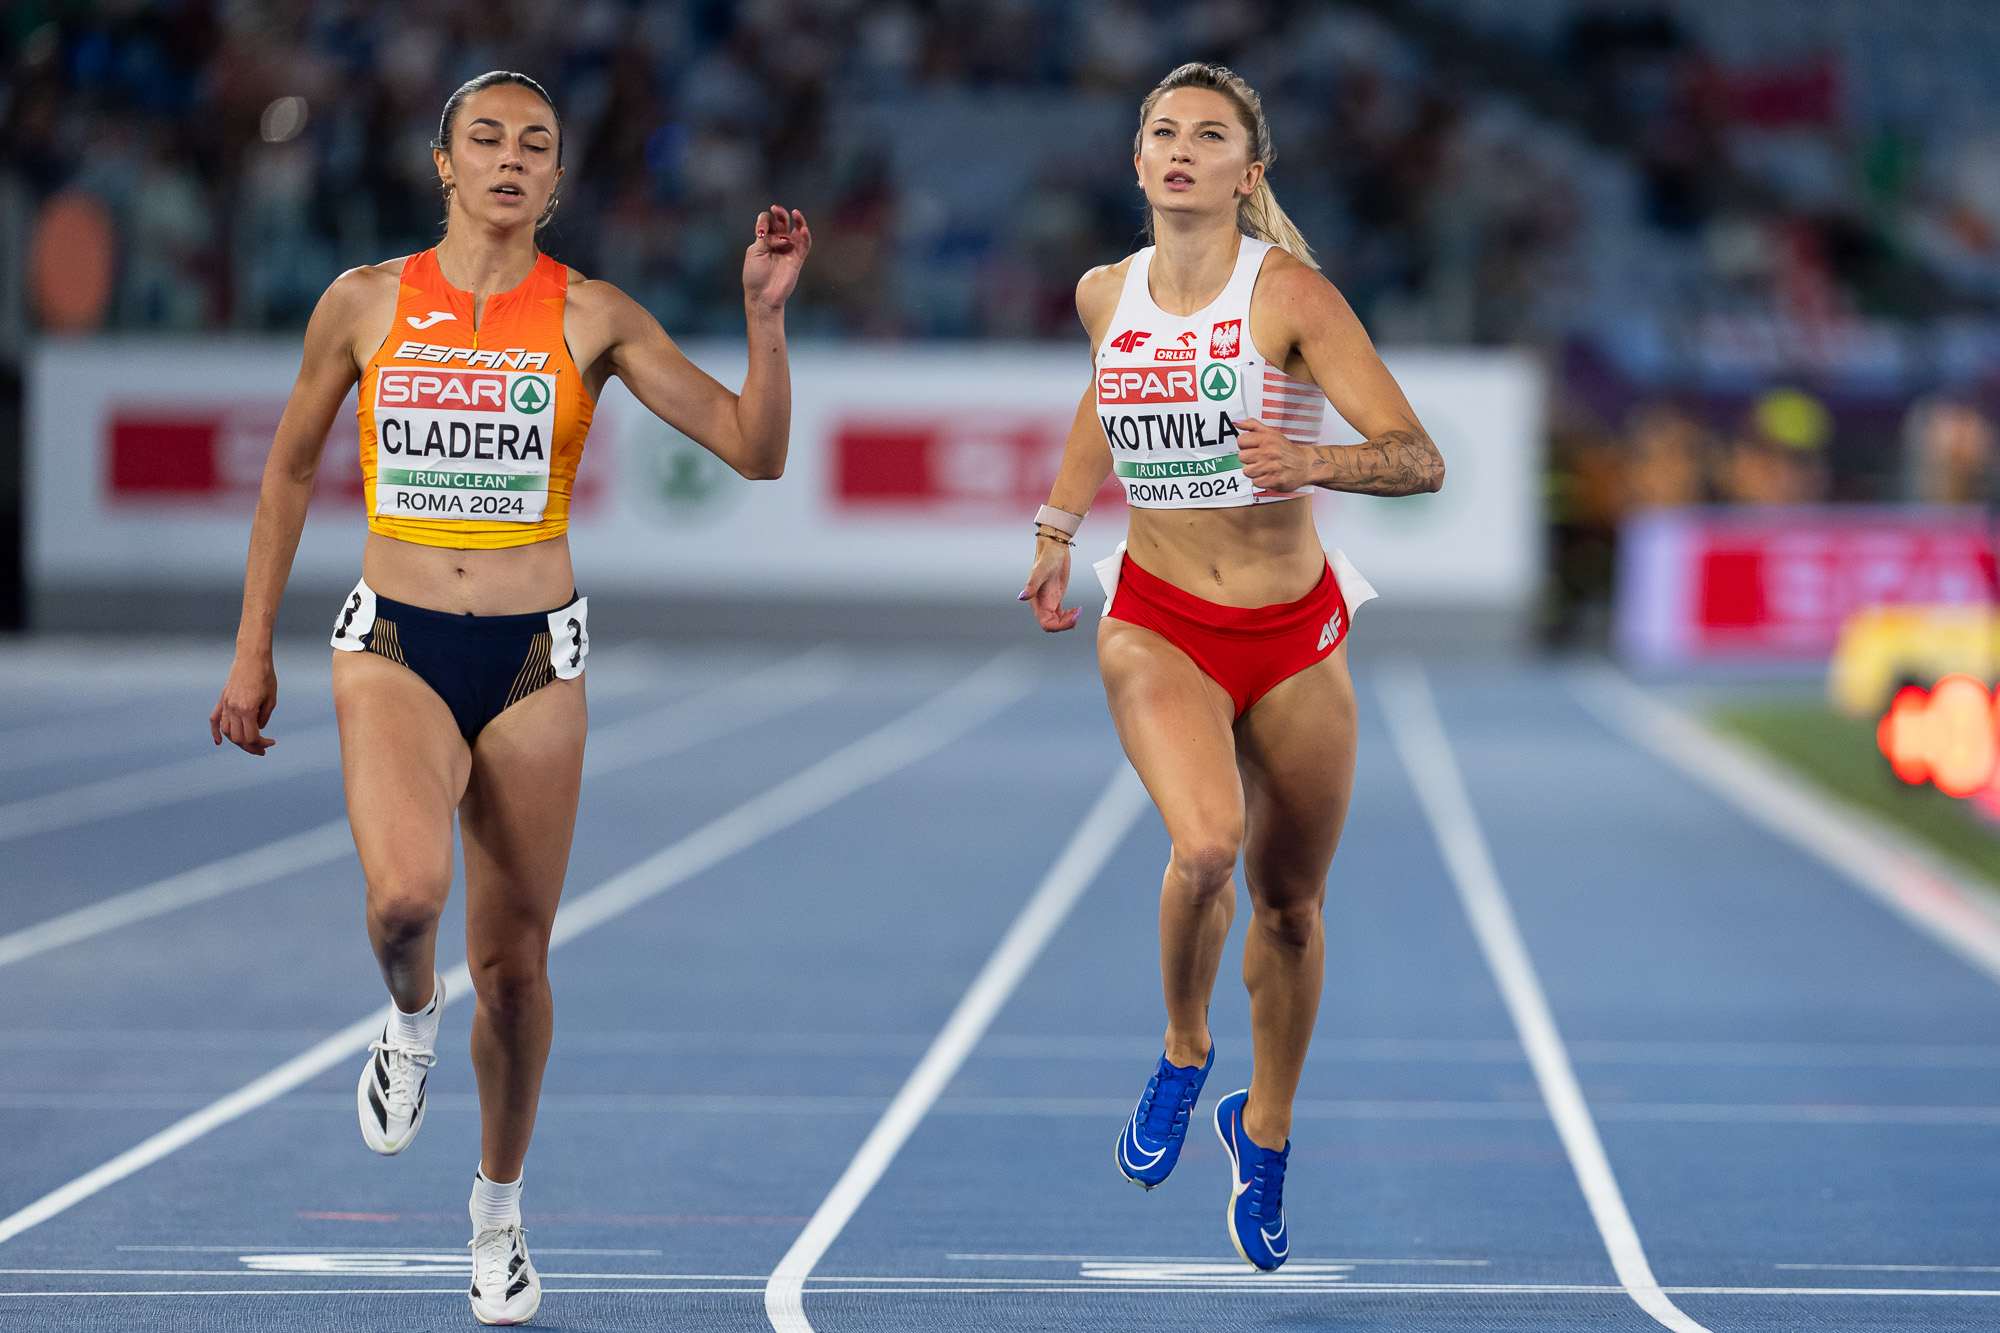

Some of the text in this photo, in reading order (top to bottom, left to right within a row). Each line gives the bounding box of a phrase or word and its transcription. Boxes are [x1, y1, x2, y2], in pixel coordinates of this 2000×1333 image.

[1111, 330, 1152, 353] 4F
[1156, 350, 1195, 360] ORLEN
[394, 341, 550, 371] ESPAÑA
[382, 375, 502, 406] SPAR
[1099, 370, 1195, 400] SPAR
[381, 418, 545, 460] CLADERA
[1101, 411, 1240, 450] KOTWIŁA
[408, 471, 414, 484] I
[415, 472, 450, 486] RUN
[1141, 464, 1167, 477] RUN
[1130, 476, 1240, 501] ROMA 2024
[397, 492, 525, 514] ROMA 2024
[1317, 606, 1342, 651] 4F
